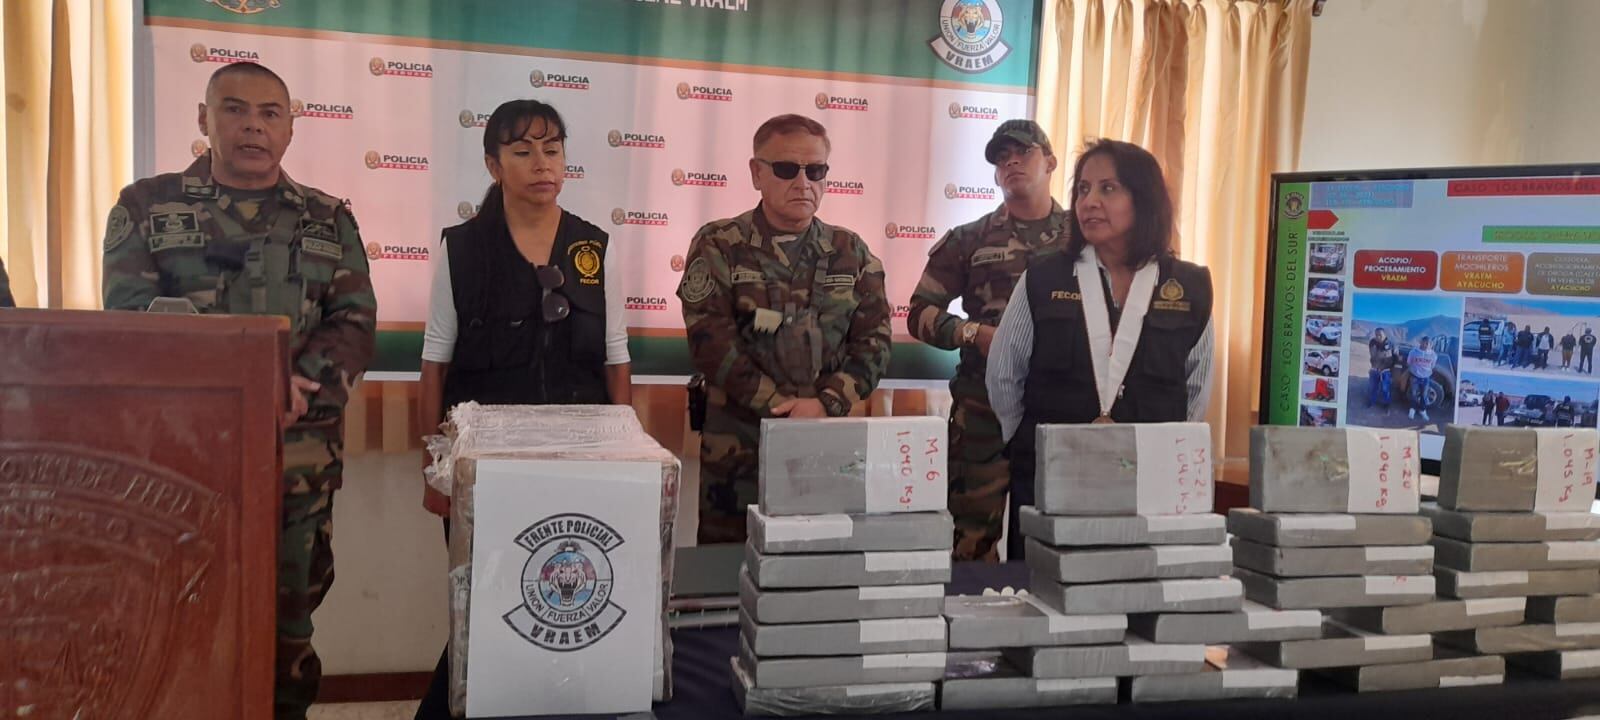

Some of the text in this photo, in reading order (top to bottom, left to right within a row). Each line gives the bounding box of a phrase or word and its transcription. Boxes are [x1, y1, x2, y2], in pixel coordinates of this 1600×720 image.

[210, 47, 259, 60] POLICIA
[945, 51, 994, 69] VRAEM
[388, 61, 433, 72] POLICIA
[547, 73, 590, 83] POLICIA
[693, 86, 733, 96] POLICIA
[830, 96, 869, 106] POLICIA
[307, 103, 353, 113] POLICIA
[963, 105, 998, 115] POLICIA
[624, 133, 665, 142] POLICIA
[383, 154, 429, 164] POLICIA
[687, 172, 727, 181] POLICIA
[827, 180, 864, 189] POLICIA
[1453, 183, 1487, 193] CASO
[1522, 182, 1570, 192] BRAVOS
[959, 186, 996, 194] POLICIA
[627, 211, 668, 220] POLICIA
[900, 225, 936, 234] POLICIA
[384, 245, 429, 255] POLICIA
[1286, 261, 1297, 280] DEL
[1364, 265, 1426, 274] PROCESAMIENTO
[1381, 274, 1408, 282] VRAEM
[1456, 281, 1505, 289] AYACUCHO
[627, 296, 667, 305] POLICIA
[1284, 285, 1296, 337] BRAVOS
[1282, 341, 1293, 365] LOS
[1280, 375, 1291, 412] CASO
[925, 438, 940, 481] M-6
[1582, 447, 1594, 486] M-19
[524, 519, 614, 548] FRENTE POLICIAL
[525, 583, 609, 623] UNION FUERZA VALOR
[530, 622, 602, 645] VRAEM
